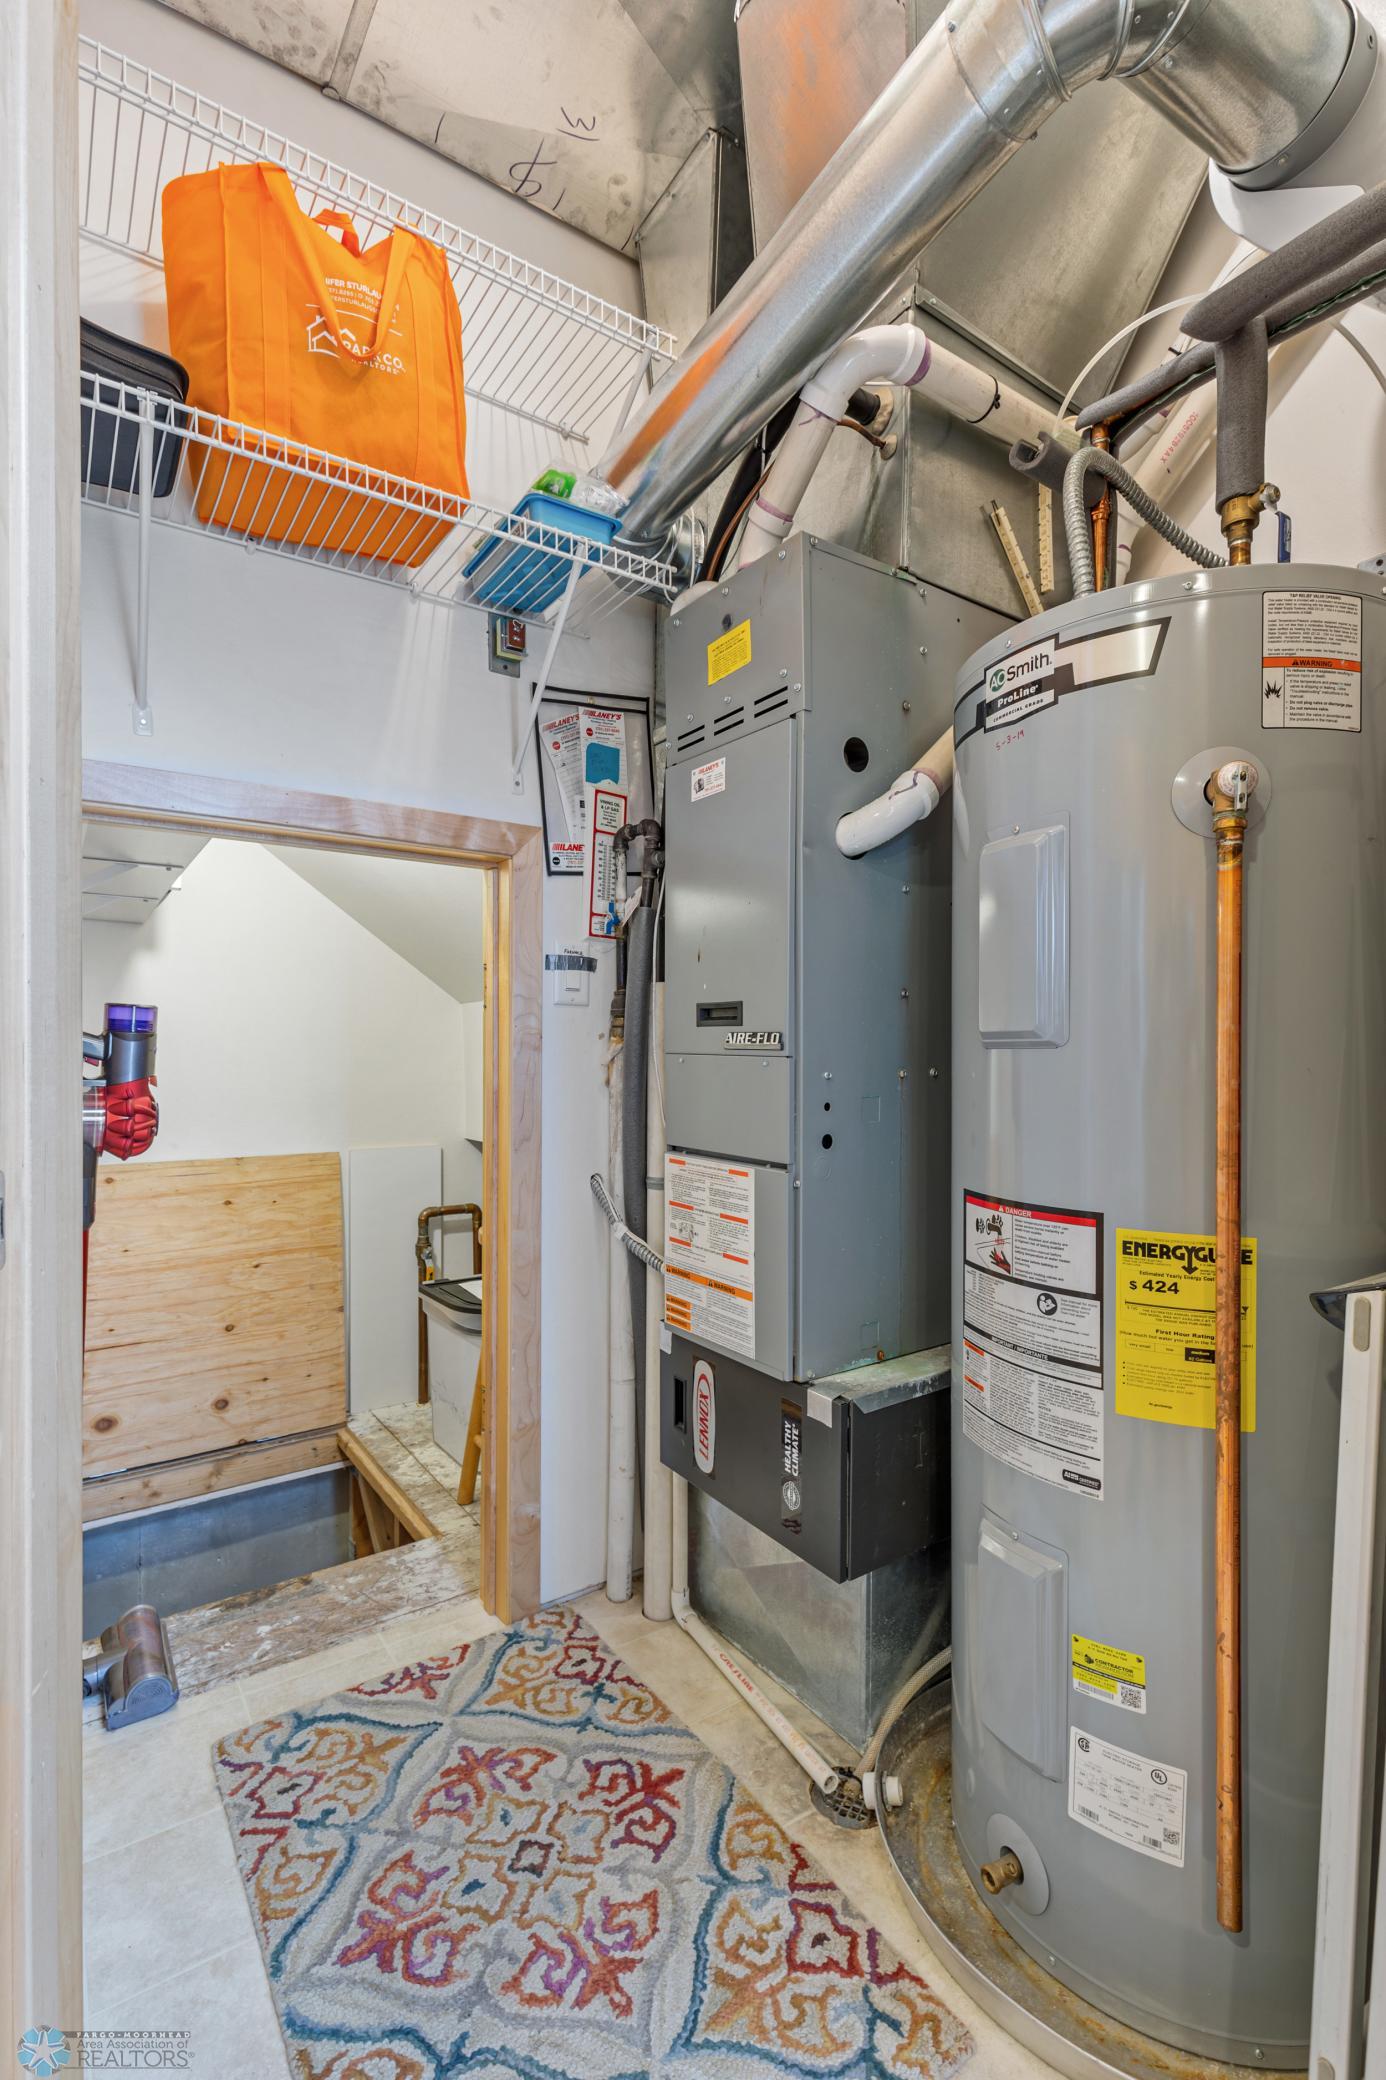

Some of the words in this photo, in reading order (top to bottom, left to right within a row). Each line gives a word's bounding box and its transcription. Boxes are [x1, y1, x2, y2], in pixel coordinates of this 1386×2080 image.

[1007, 653, 1049, 681] Smith
[998, 686, 1036, 708] ProLine
[559, 843, 585, 851] LANE
[725, 1032, 780, 1045] AIRE-FLO
[1005, 1207, 1032, 1218] DANGER
[1140, 1270, 1164, 1278] Estimated
[1129, 1280, 1137, 1290] $
[1142, 1280, 1180, 1294] 424
[1192, 1333, 1215, 1341] Rating
[697, 1390, 710, 1461] LENNOX
[784, 1421, 792, 1473] HEALTHY
[1095, 1658, 1133, 1673] CONTRACTOR
